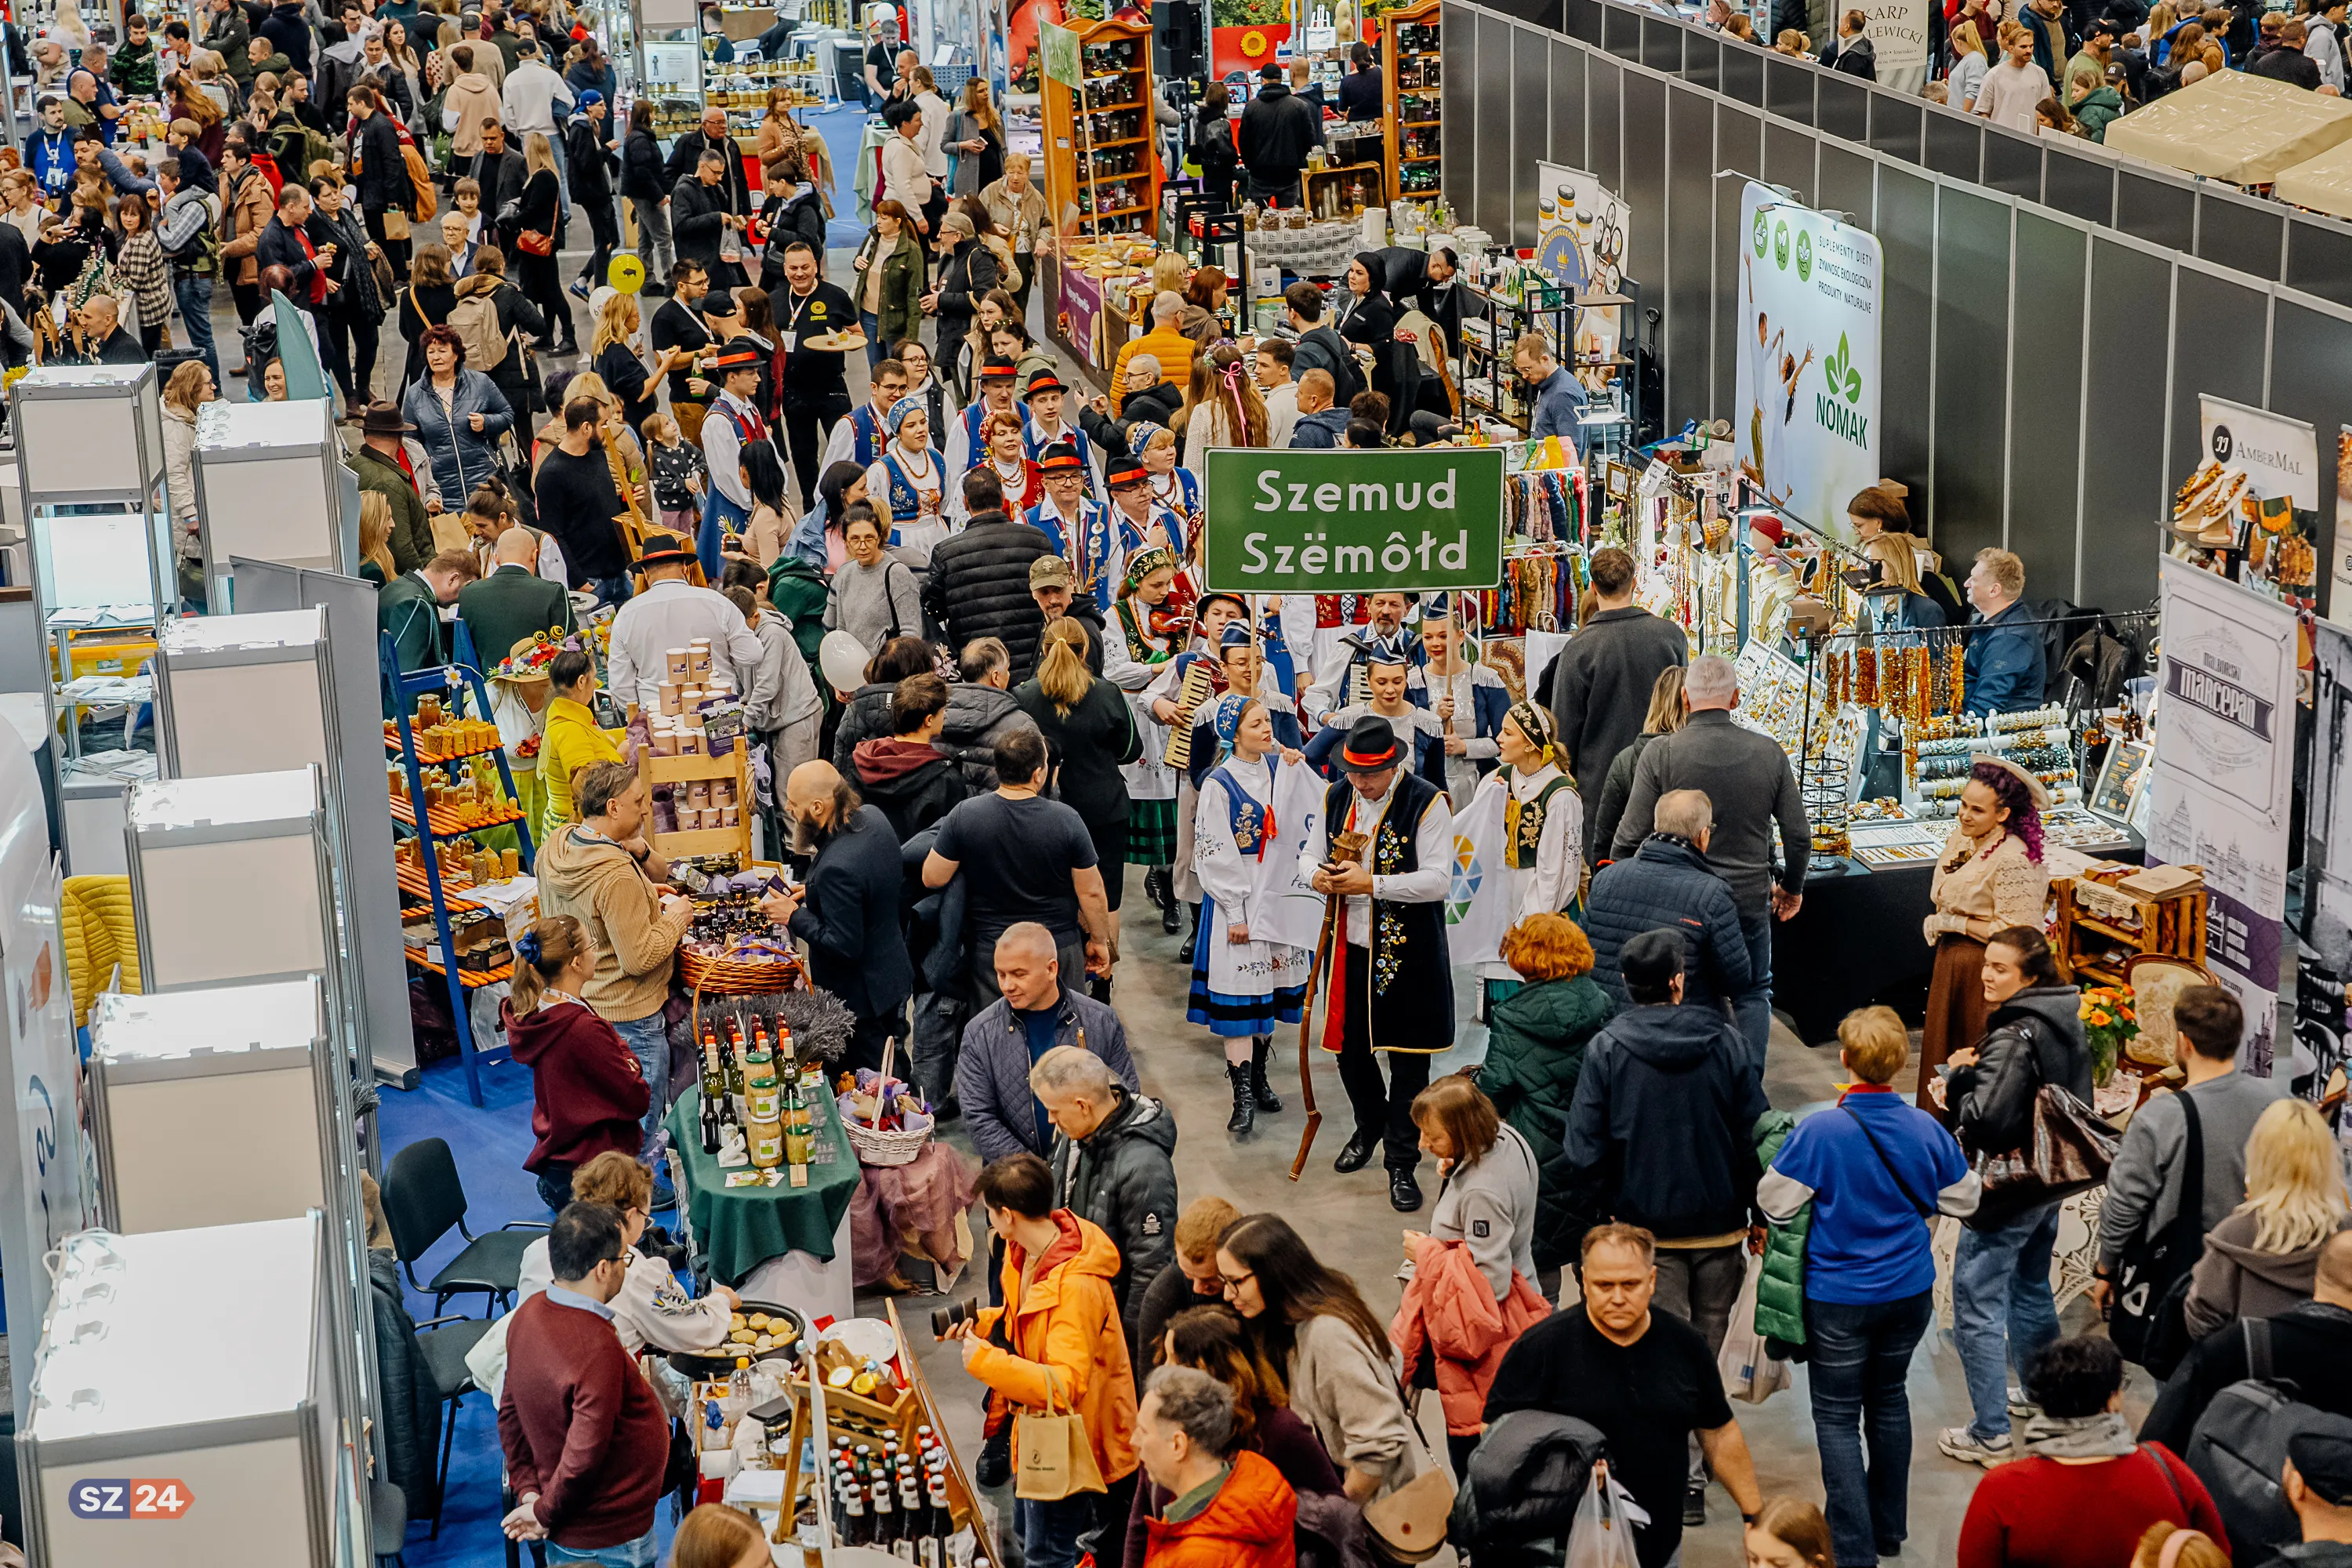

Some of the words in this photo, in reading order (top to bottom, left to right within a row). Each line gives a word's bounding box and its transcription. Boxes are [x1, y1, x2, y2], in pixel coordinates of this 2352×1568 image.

[1867, 26, 1923, 45] LEWICKI
[1777, 246, 1786, 263] bio
[1819, 236, 1854, 260] SUPLEMENTY
[1856, 250, 1872, 267] DIETY
[1841, 268, 1872, 291] EKOLOGICZNA
[1818, 281, 1842, 301] PRODUKTY
[1844, 292, 1871, 314] NATURALNE
[1816, 392, 1867, 451] NOMAK
[1254, 468, 1457, 512] Szemud
[1240, 530, 1468, 575] Szëmôłd
